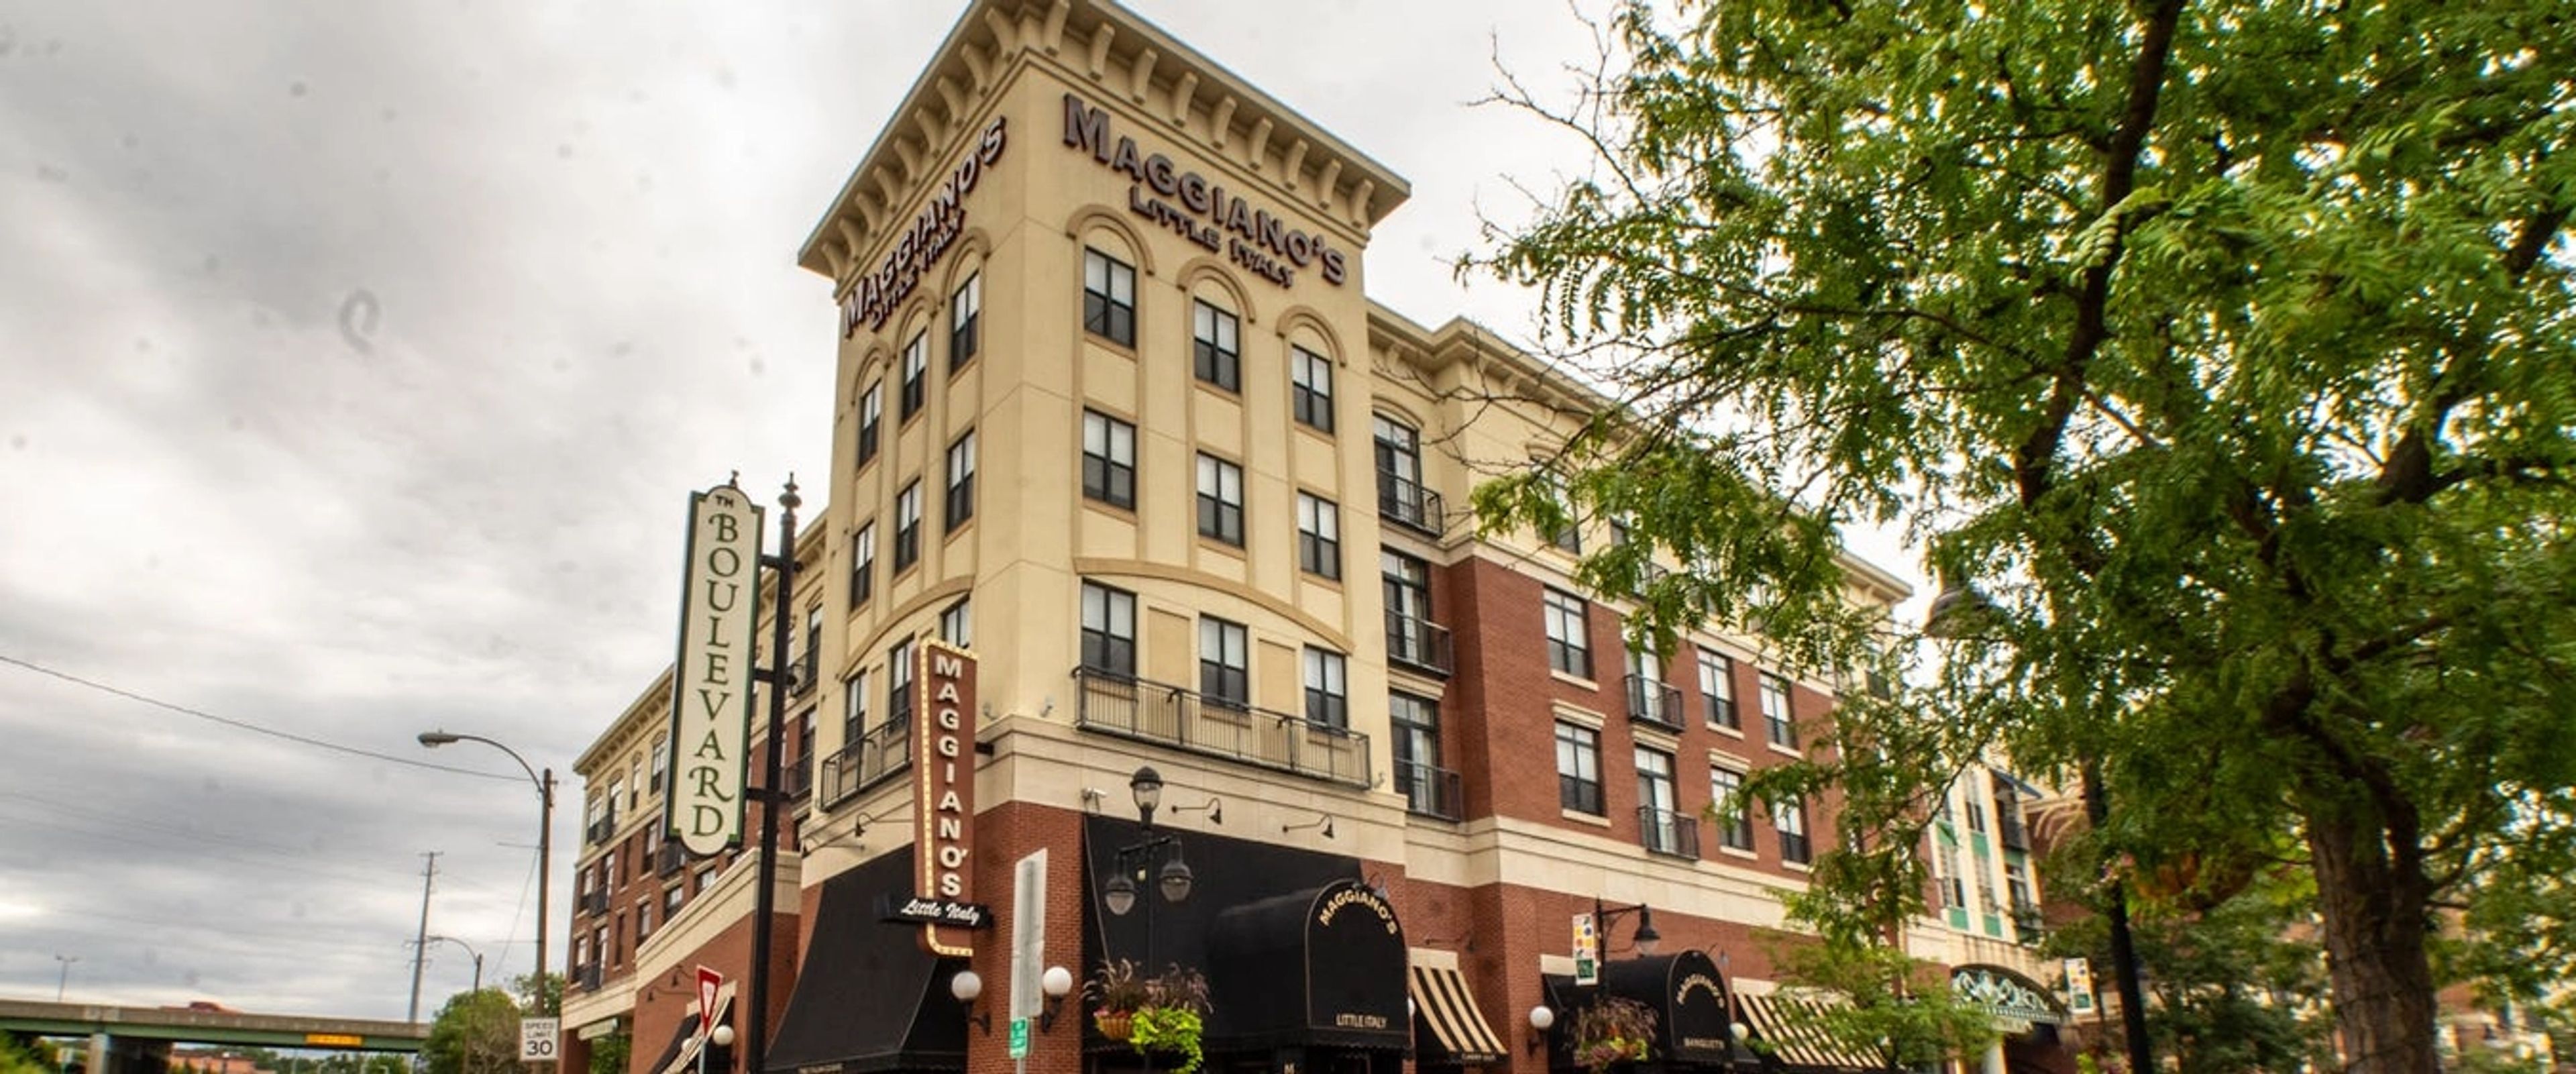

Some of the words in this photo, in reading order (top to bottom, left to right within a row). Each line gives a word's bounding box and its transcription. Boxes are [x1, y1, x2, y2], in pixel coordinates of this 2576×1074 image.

[1063, 93, 1346, 286] MAGGIANO'S
[845, 115, 1006, 339] MAGGIANO'S
[1130, 186, 1221, 254] LITTLE
[1229, 237, 1294, 288] ITALY
[688, 513, 741, 837] BOULEVARD
[936, 654, 968, 897] MAGGIANO'S
[900, 898, 942, 917] Little
[945, 902, 979, 926] Italy
[1319, 889, 1398, 935] MAGGIANO'S
[527, 1030, 552, 1039] LIMIT
[527, 1039, 553, 1057] 30
[1335, 1012, 1364, 1028] LITTLE
[1364, 1014, 1388, 1030] ITALY
